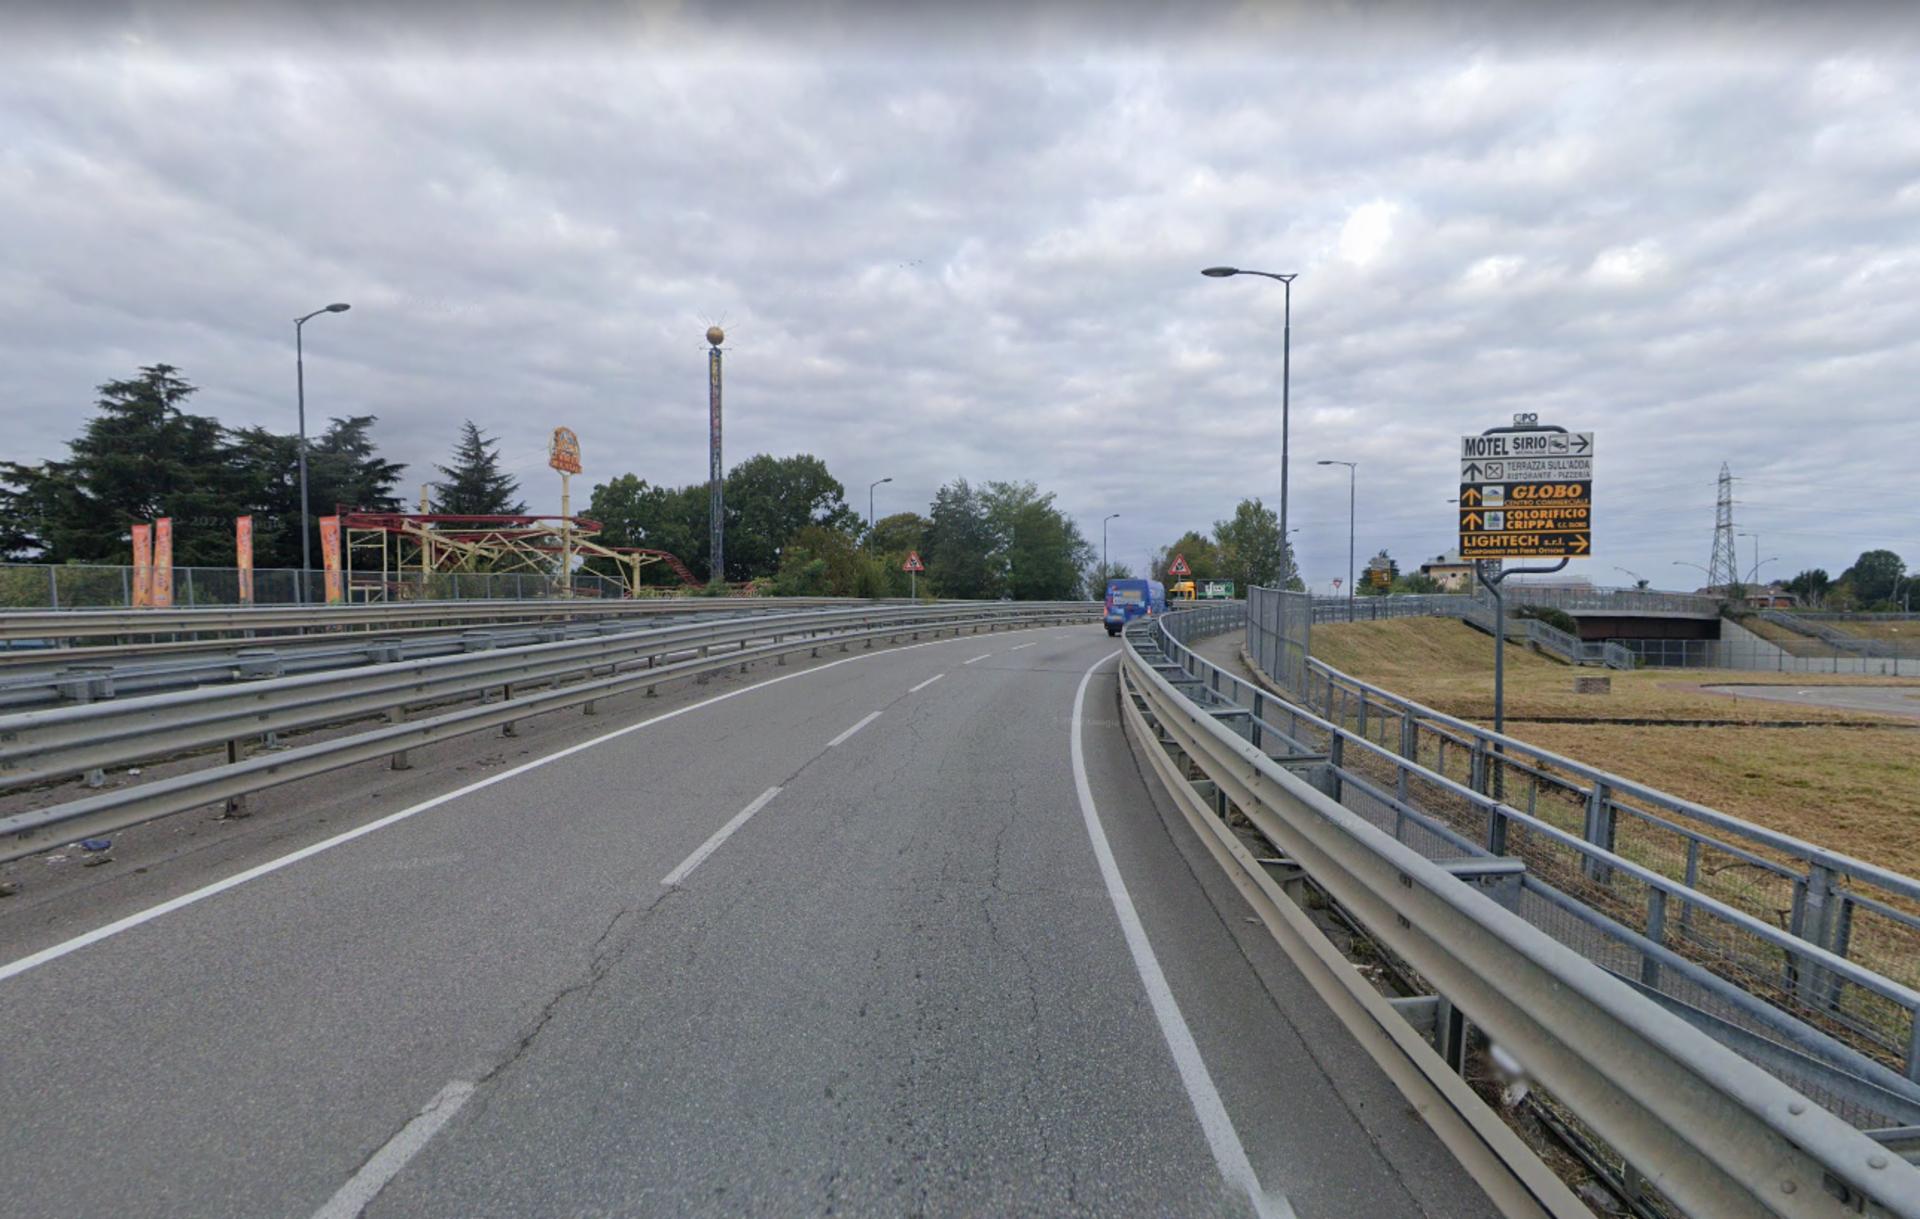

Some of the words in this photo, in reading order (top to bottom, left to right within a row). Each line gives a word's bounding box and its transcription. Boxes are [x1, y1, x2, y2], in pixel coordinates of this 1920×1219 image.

[1465, 438, 1509, 456] MOTEL
[1513, 436, 1547, 449] SIRIO
[1507, 461, 1546, 471] TERRAZZA
[1507, 471, 1551, 480] RISTORANTE
[1558, 471, 1590, 479] PIZZERIA
[1512, 484, 1582, 498] GLOBO
[1506, 509, 1587, 519] COLORIFICIO
[1506, 519, 1555, 529] CRIPPA
[1464, 535, 1539, 547] LIGHTECH
